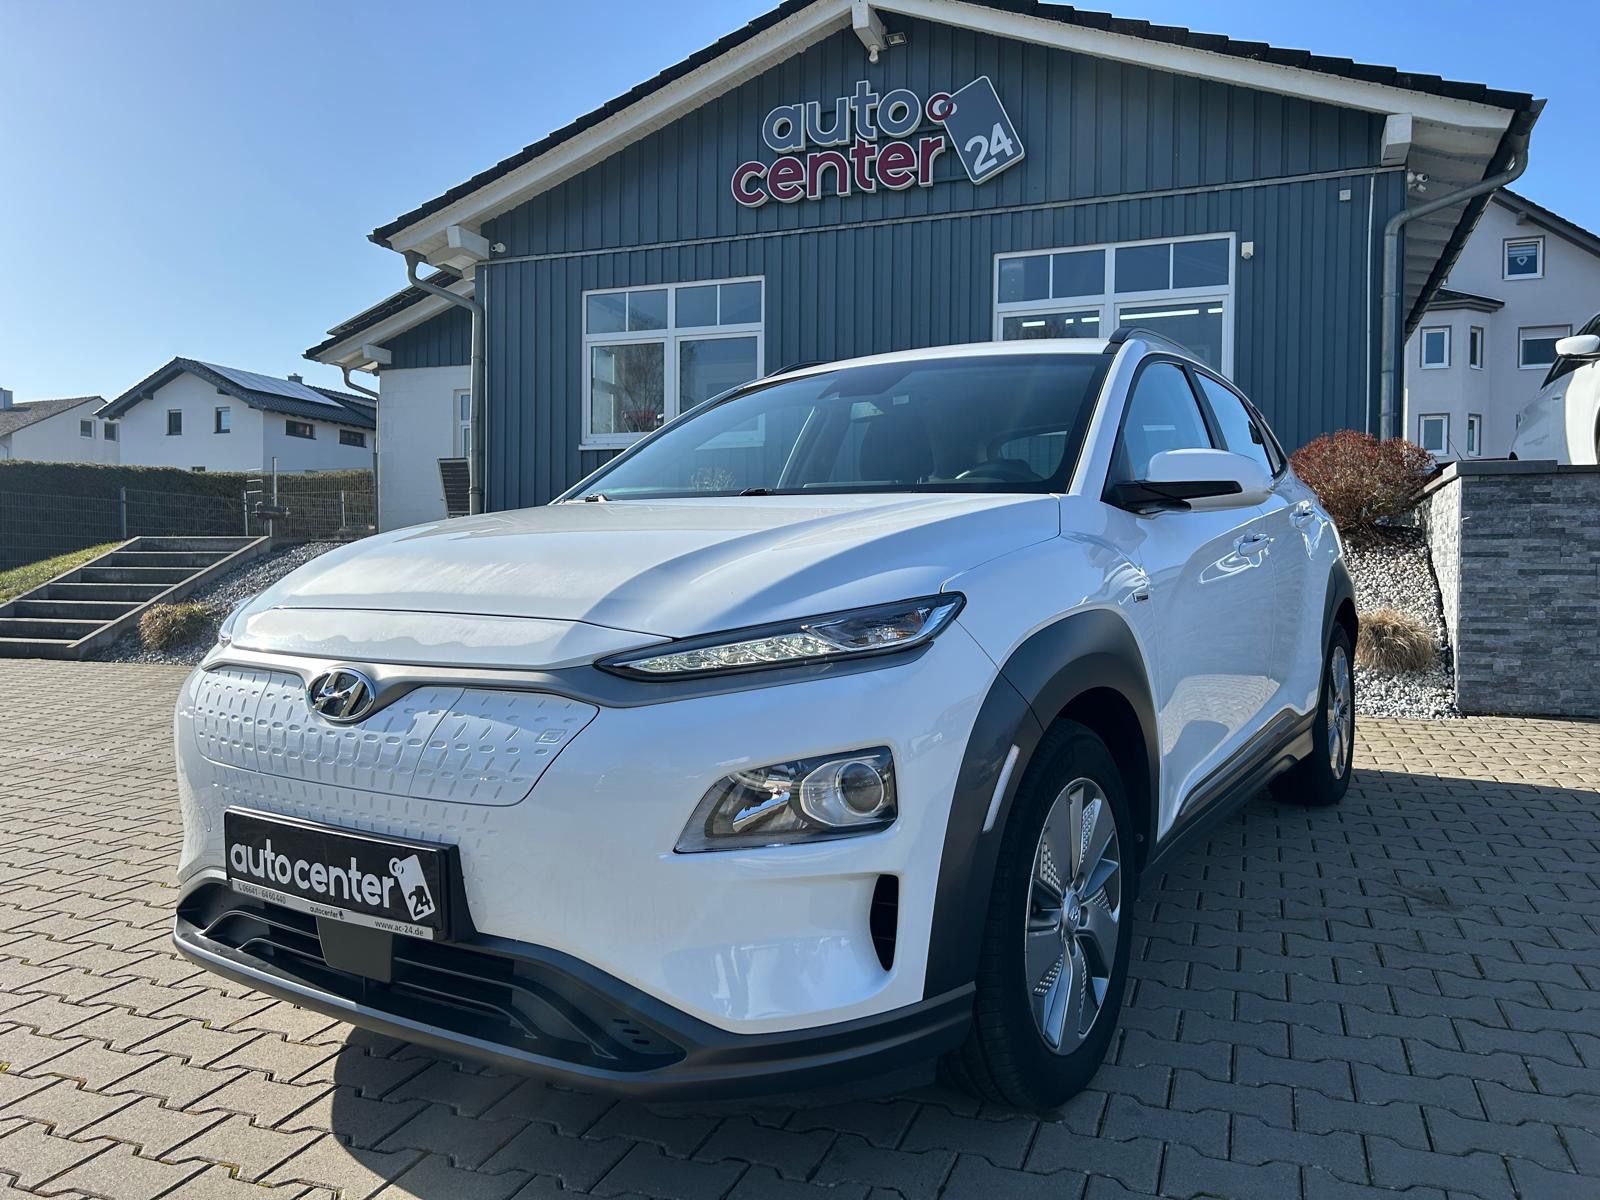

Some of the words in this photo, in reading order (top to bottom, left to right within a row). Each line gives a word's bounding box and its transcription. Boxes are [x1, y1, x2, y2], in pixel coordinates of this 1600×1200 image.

[762, 80, 922, 153] auto
[731, 135, 945, 208] center
[964, 122, 1014, 176] 24
[230, 838, 395, 908] autocenter
[408, 885, 431, 917] 24
[309, 905, 338, 918] autocenter
[374, 920, 424, 936] www.ac-24.de
